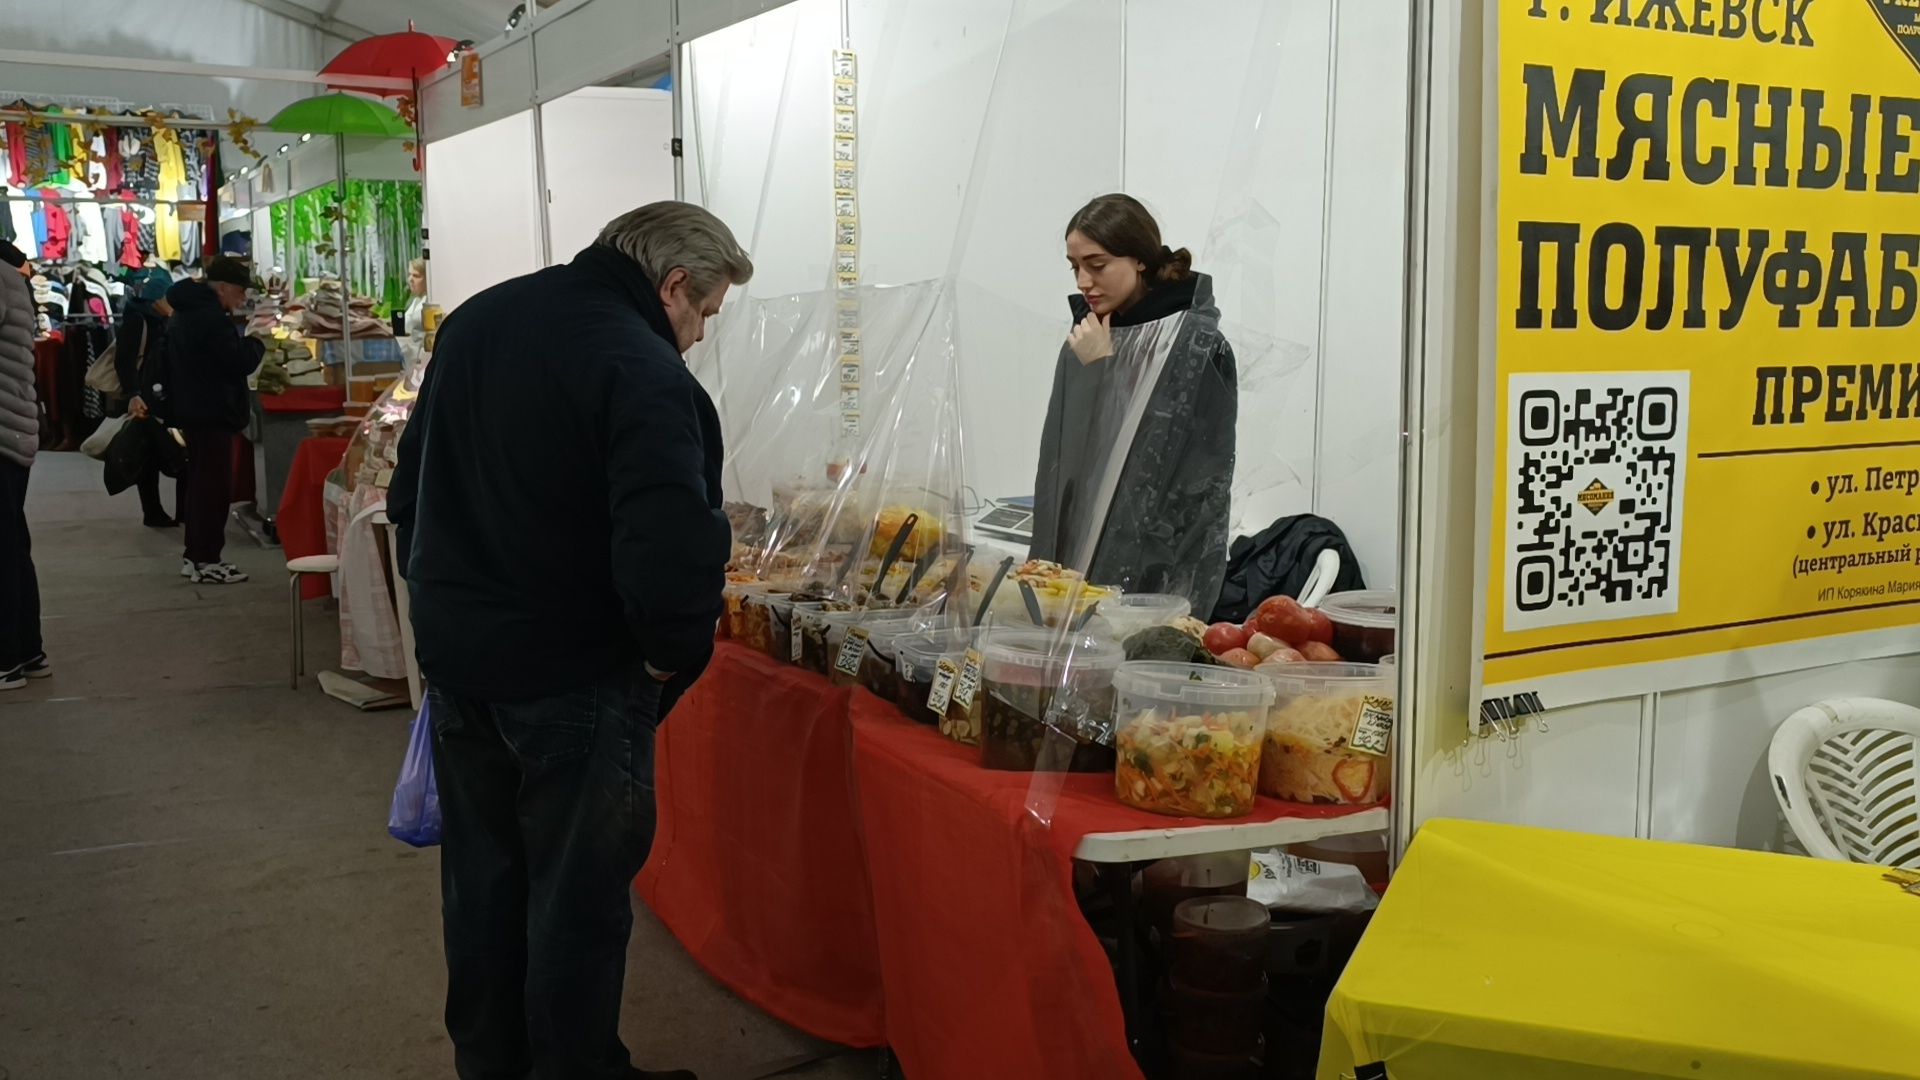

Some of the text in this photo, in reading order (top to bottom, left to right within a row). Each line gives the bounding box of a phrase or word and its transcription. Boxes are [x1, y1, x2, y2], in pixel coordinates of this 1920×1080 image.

[1520, 63, 1920, 193] МЯСНЫЕ
[1516, 221, 1920, 331] ПОЛУФАБ
[1825, 466, 1920, 502] ул. Петр
[1822, 519, 1855, 548] ул.
[1793, 543, 1912, 579] (центральный
[1818, 587, 1835, 601] ИП
